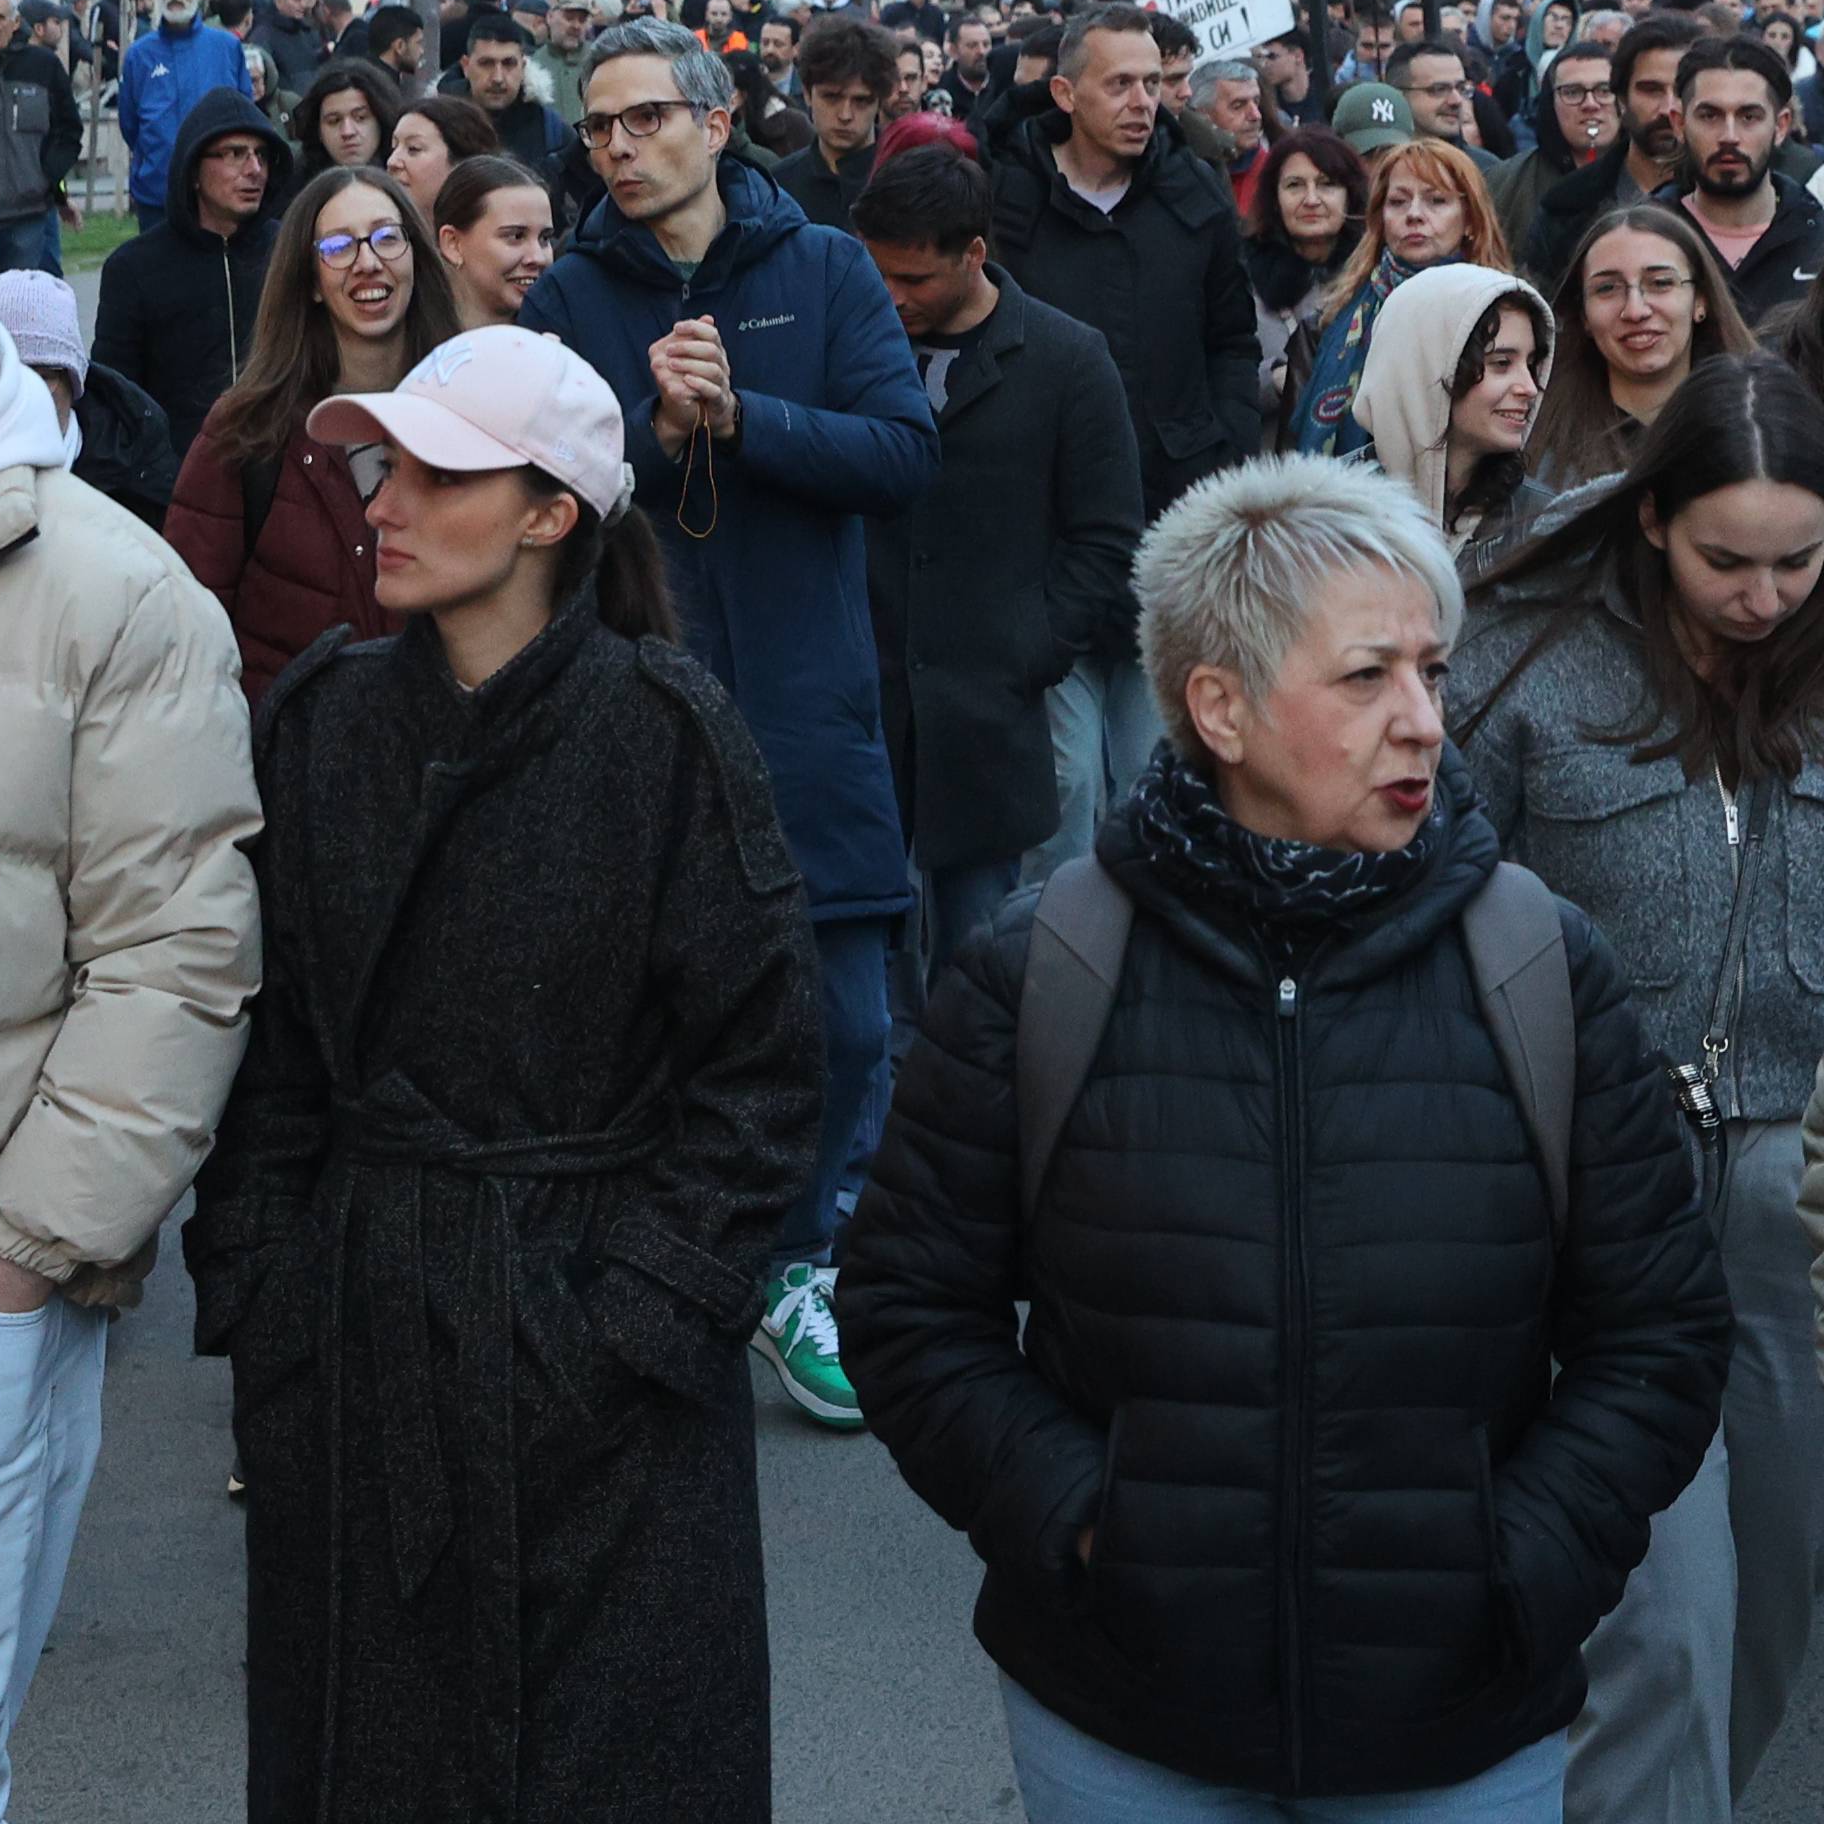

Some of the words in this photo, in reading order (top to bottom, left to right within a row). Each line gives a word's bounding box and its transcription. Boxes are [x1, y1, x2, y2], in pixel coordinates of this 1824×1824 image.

[1208, 19, 1233, 51] СИ
[1371, 97, 1395, 123] NY
[748, 313, 796, 329] Columbia
